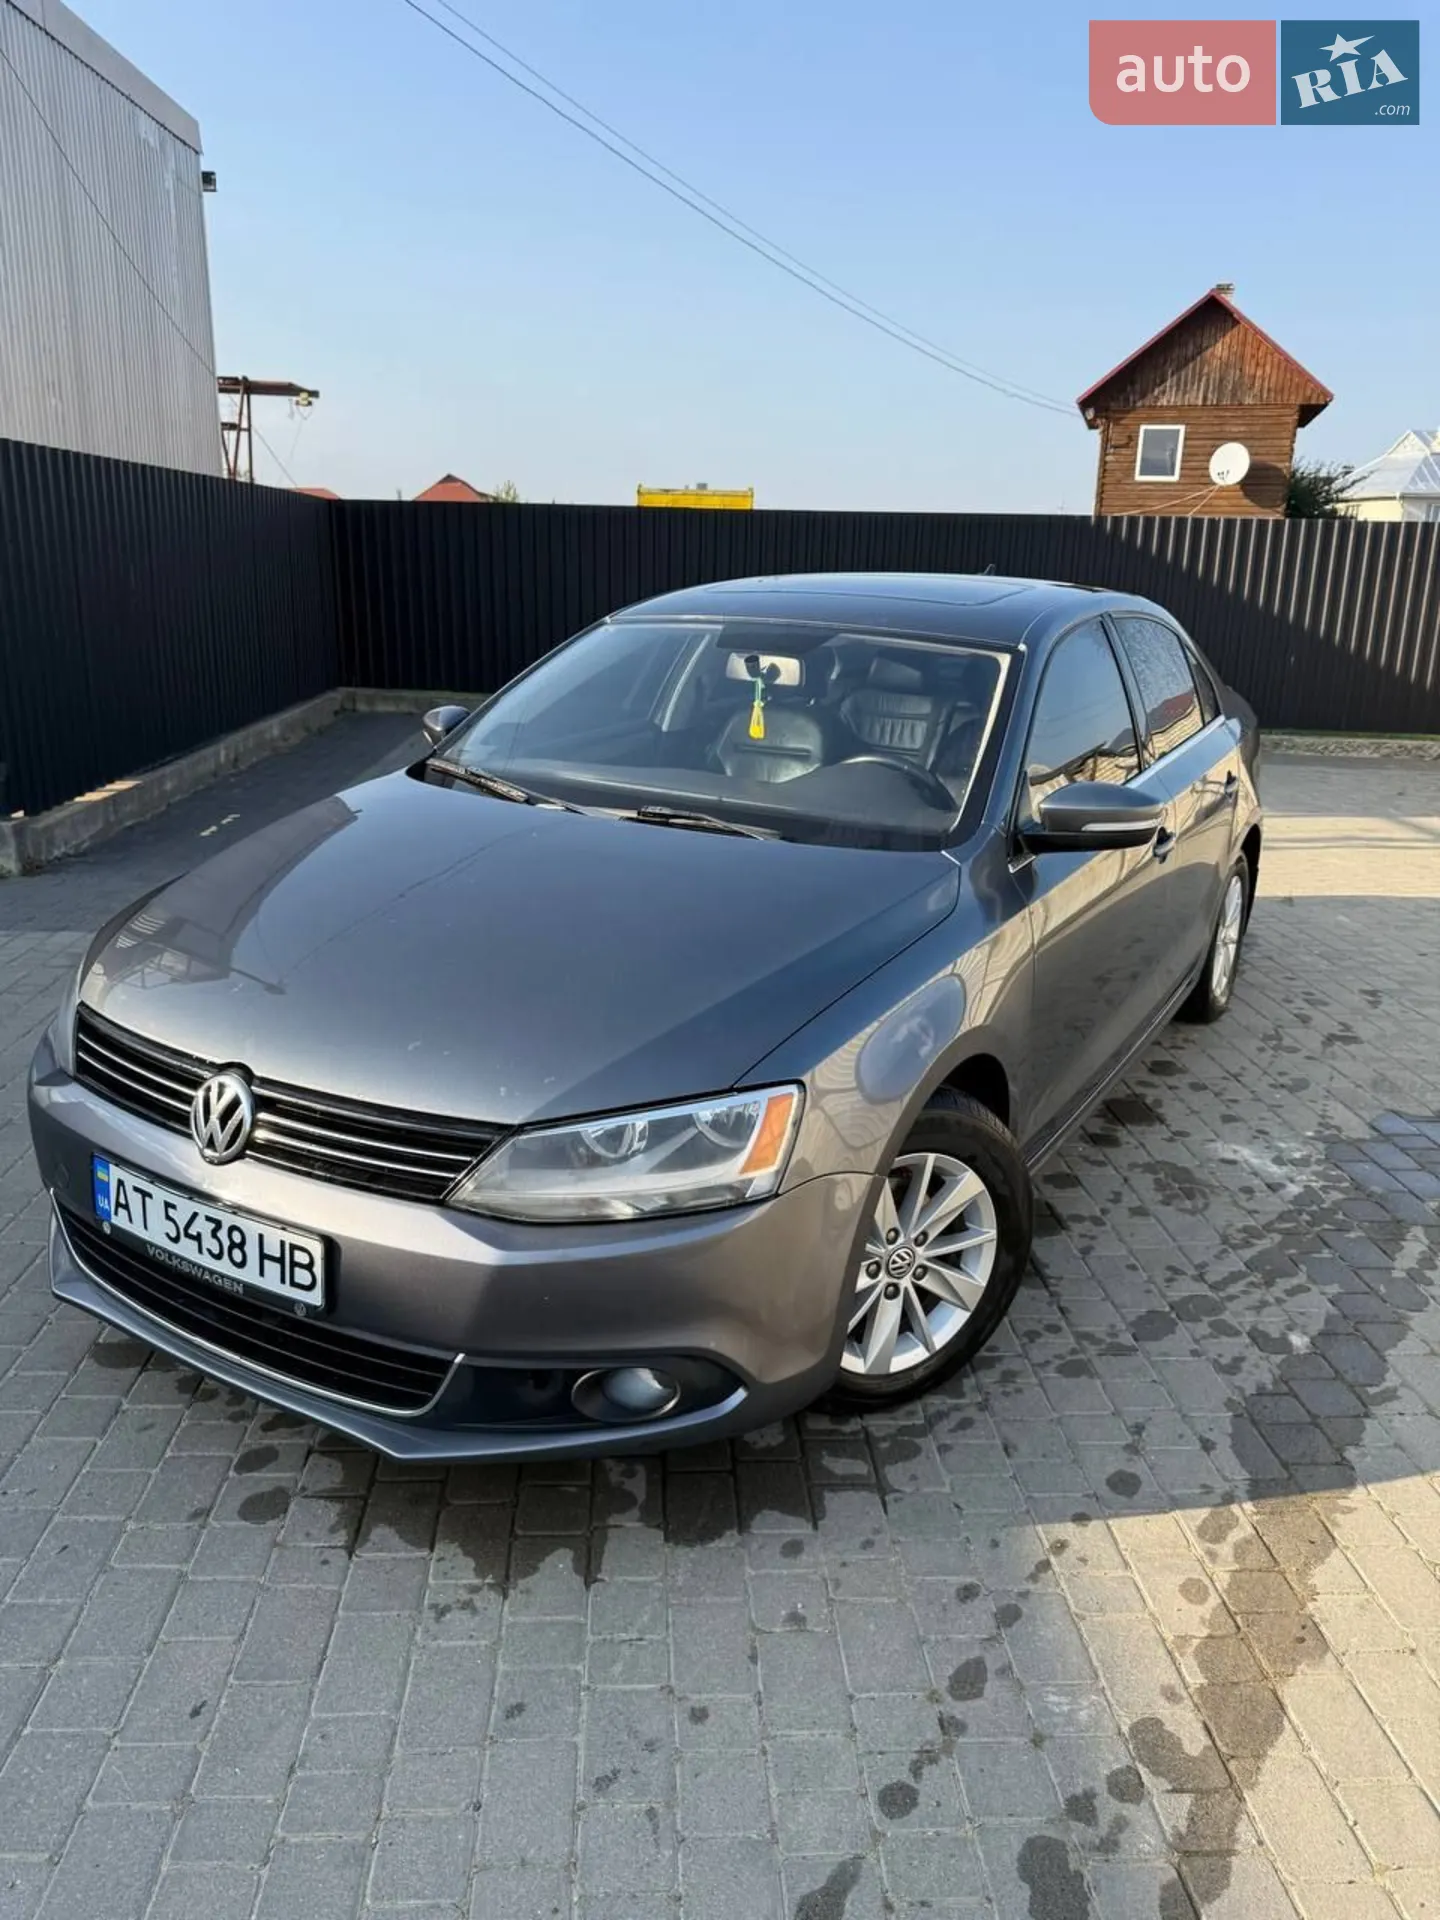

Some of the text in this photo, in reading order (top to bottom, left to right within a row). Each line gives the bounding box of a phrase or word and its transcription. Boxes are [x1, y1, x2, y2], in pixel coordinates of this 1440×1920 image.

[98, 1194, 110, 1211] UA
[114, 1178, 317, 1292] AT 5438 HB
[147, 1244, 244, 1295] VOLKSWAGEN
